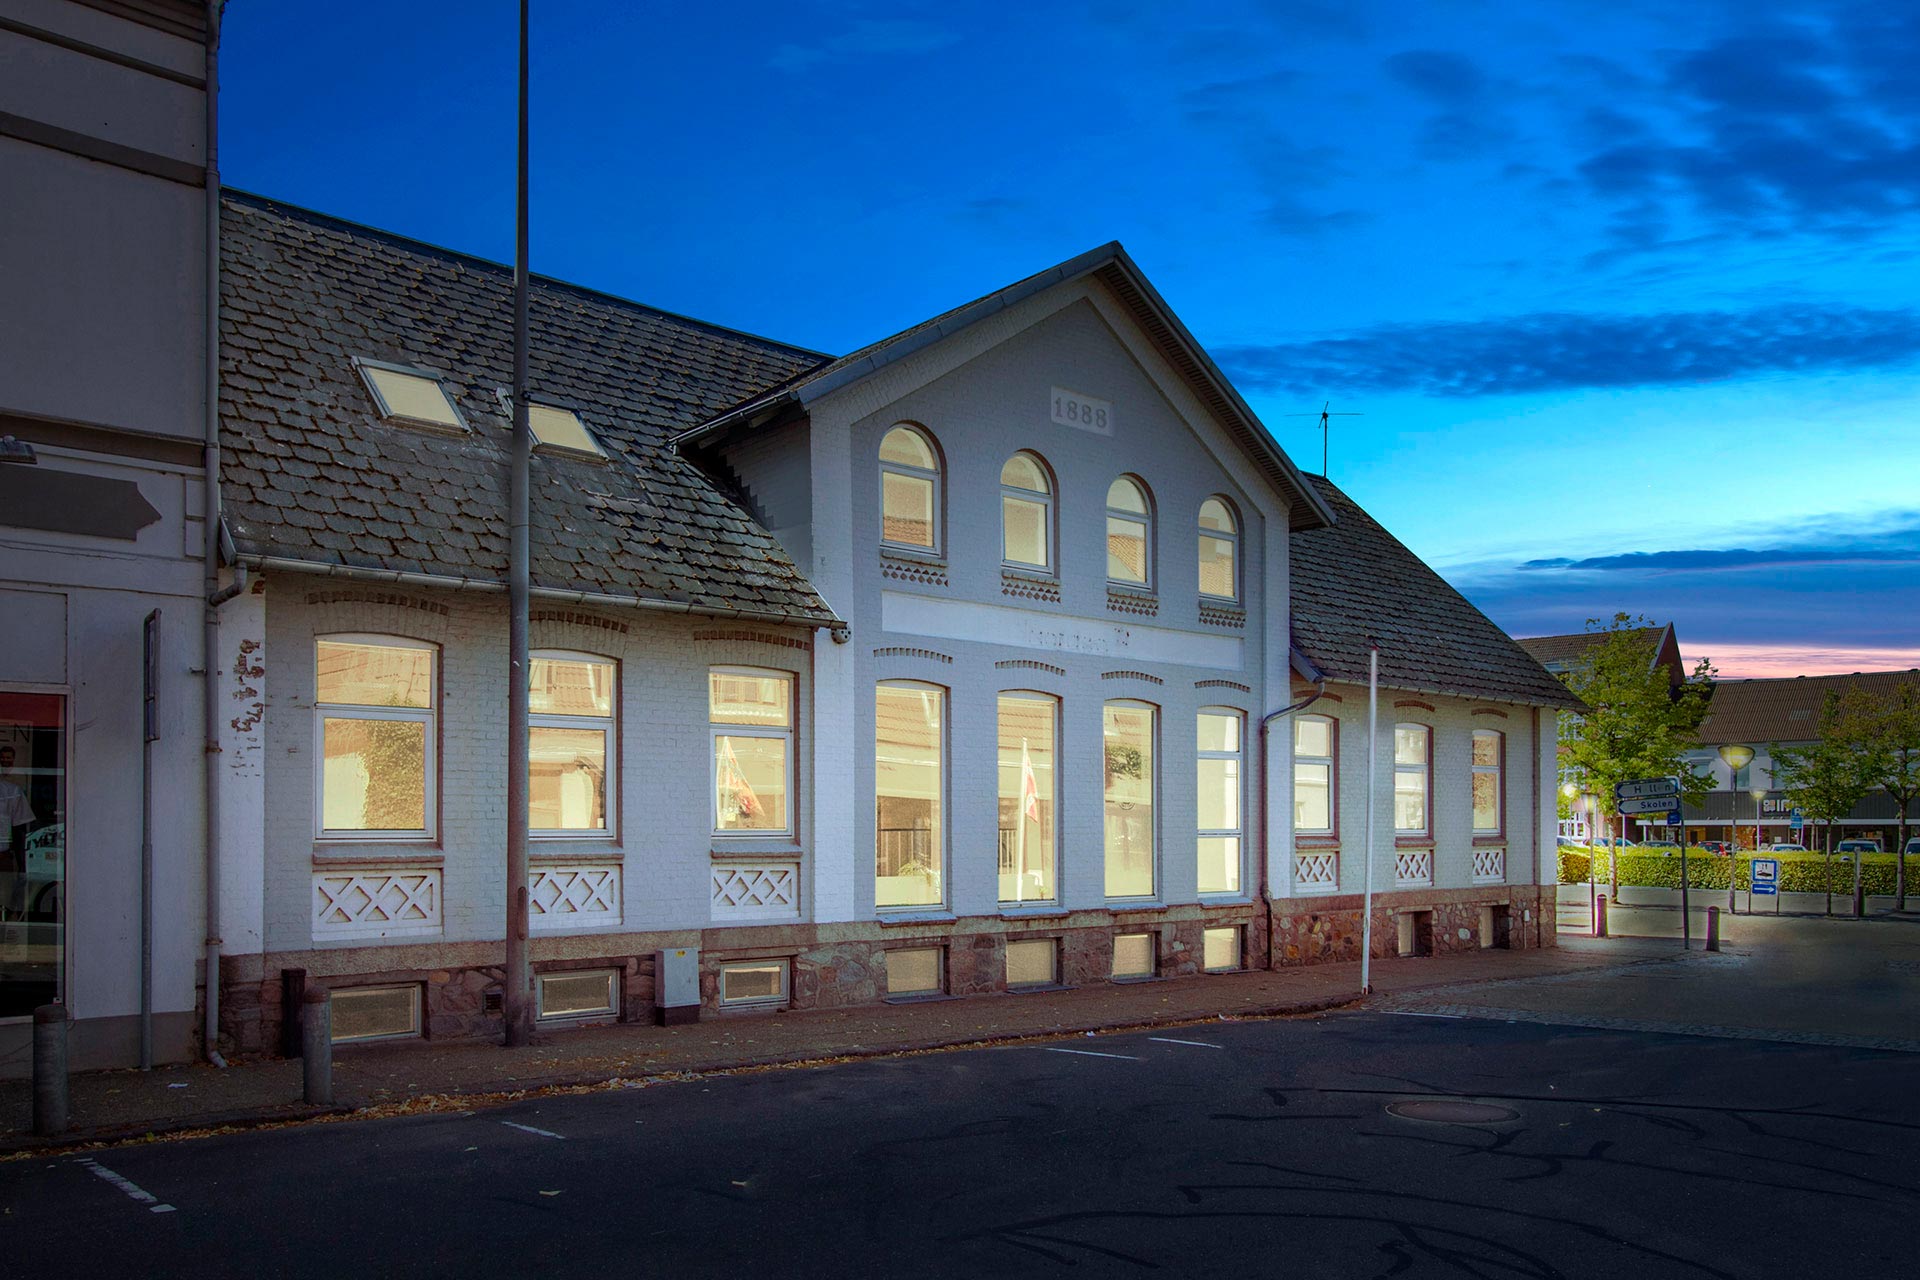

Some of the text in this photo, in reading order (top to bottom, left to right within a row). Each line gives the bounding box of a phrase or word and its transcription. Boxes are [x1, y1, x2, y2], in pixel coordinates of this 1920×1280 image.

[1055, 397, 1108, 428] 1888
[1633, 784, 1671, 794] Hlln
[1640, 800, 1673, 809] Skolen
